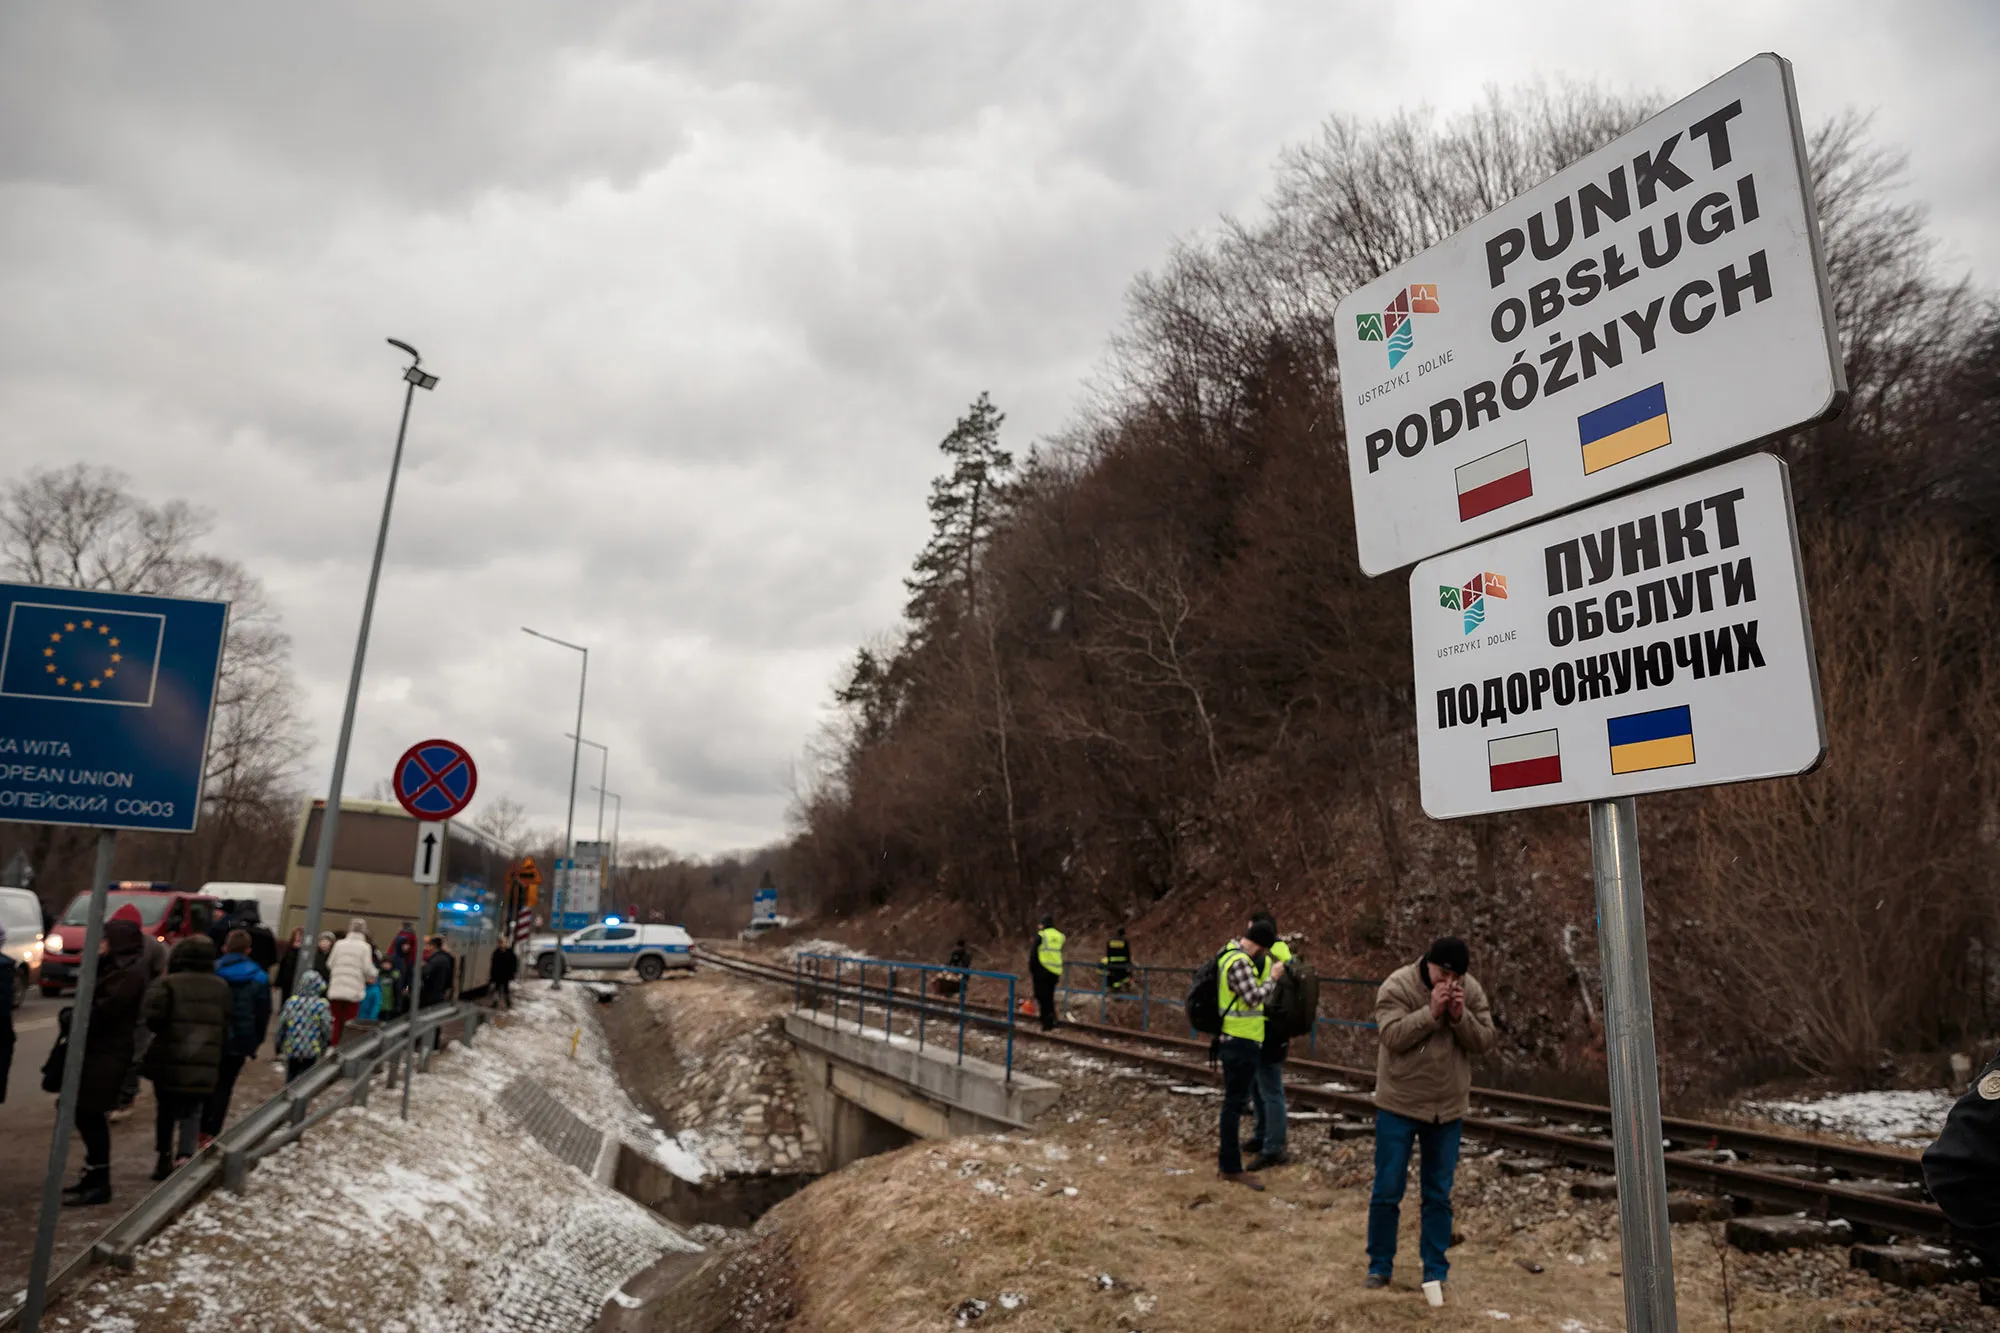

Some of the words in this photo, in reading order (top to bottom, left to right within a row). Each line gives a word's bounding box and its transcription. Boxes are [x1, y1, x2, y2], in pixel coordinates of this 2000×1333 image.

[1485, 99, 1742, 288] PUNKT
[1490, 173, 1760, 343] OBSŁUGI
[1358, 371, 1411, 406] USTRZYKI
[1418, 349, 1454, 377] DOLNE
[1365, 249, 1773, 474] PODRÓŻNYCH
[1544, 487, 1745, 597] ПУНКТ
[1437, 639, 1481, 659] USTRZYKI
[1487, 630, 1517, 646] DOLNE
[1547, 556, 1757, 647] ОБСЛУГИ
[1436, 619, 1766, 729] ПОДОРОЖУЮЧИХ
[23, 739, 72, 757] WITA
[69, 769, 133, 788] UNION
[115, 798, 174, 818] СОЮЗ
